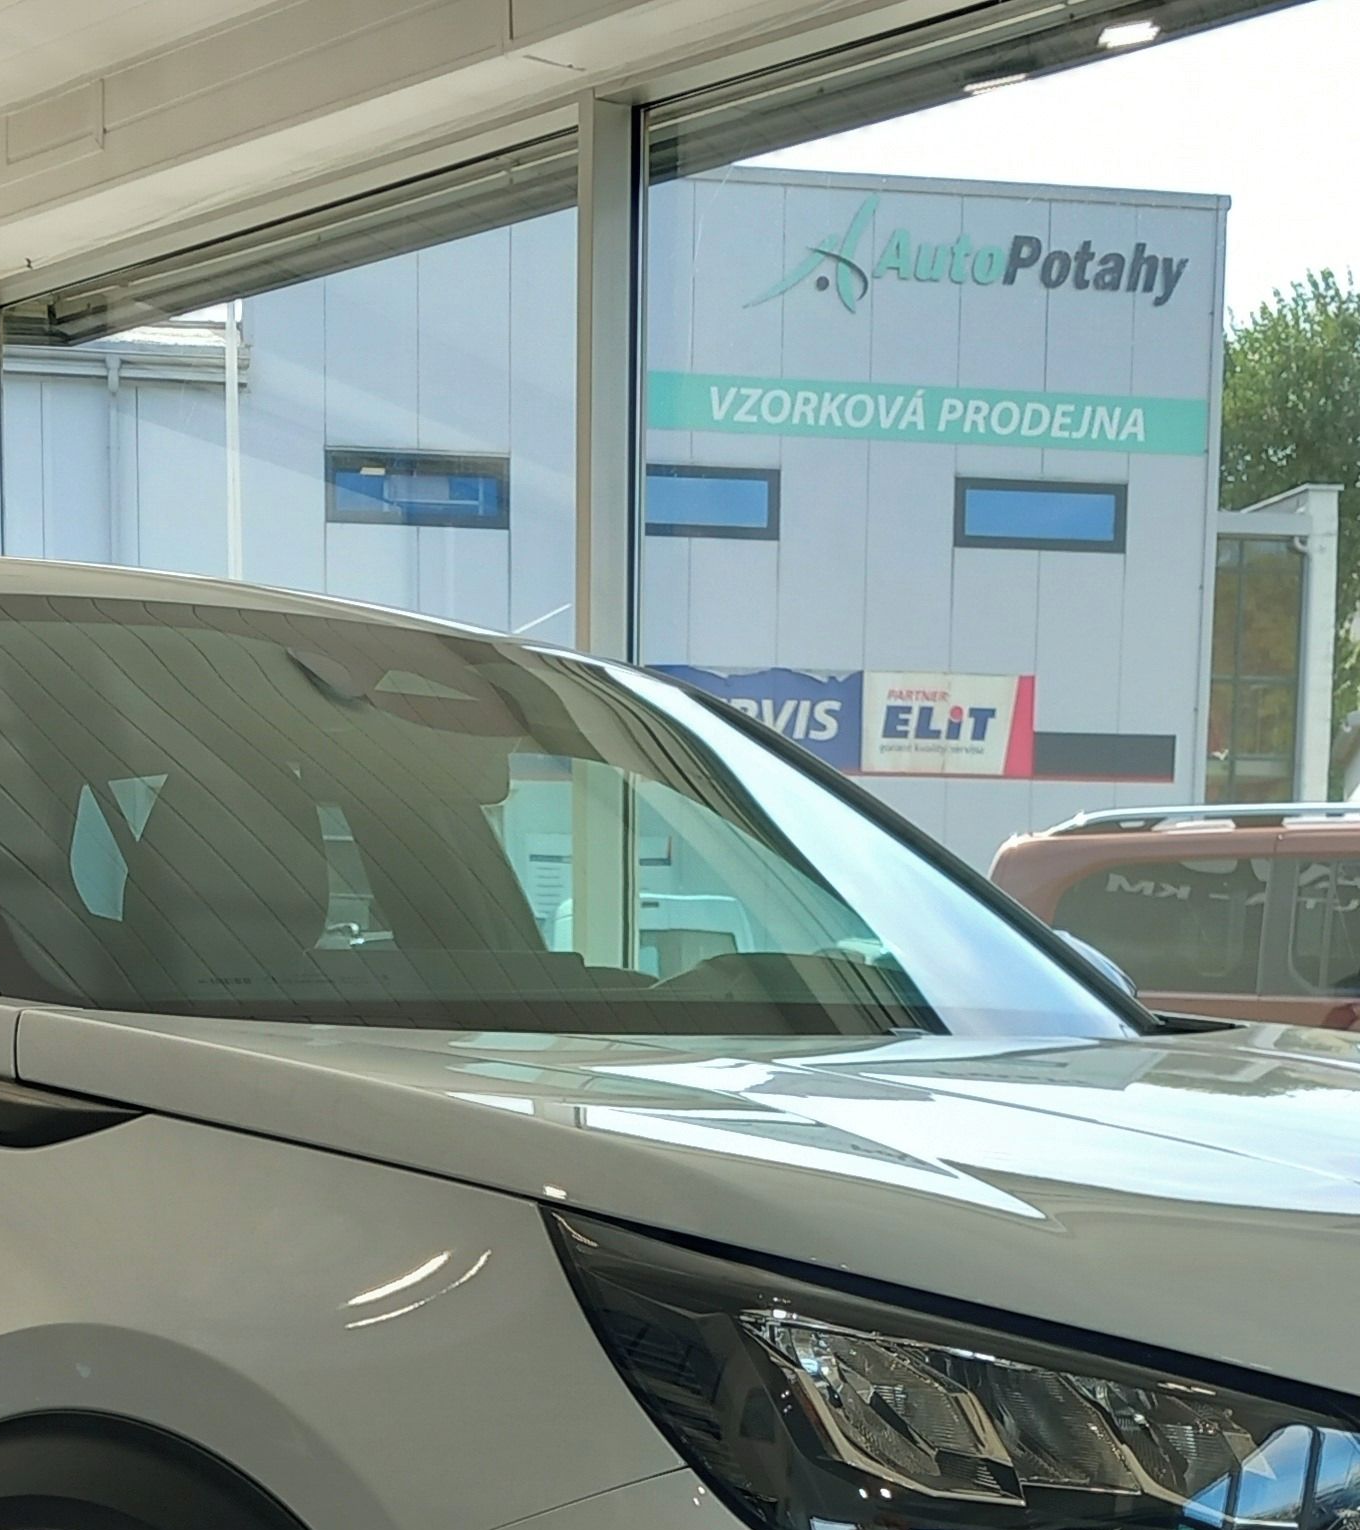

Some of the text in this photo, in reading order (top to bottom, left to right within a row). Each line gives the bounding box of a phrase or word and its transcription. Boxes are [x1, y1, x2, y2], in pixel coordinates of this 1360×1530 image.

[873, 228, 1190, 307] AutoPotahy
[708, 385, 1147, 442] VZORKOVÁ PRODEJNA
[725, 698, 842, 742] RVIS
[887, 689, 950, 703] PARTNER
